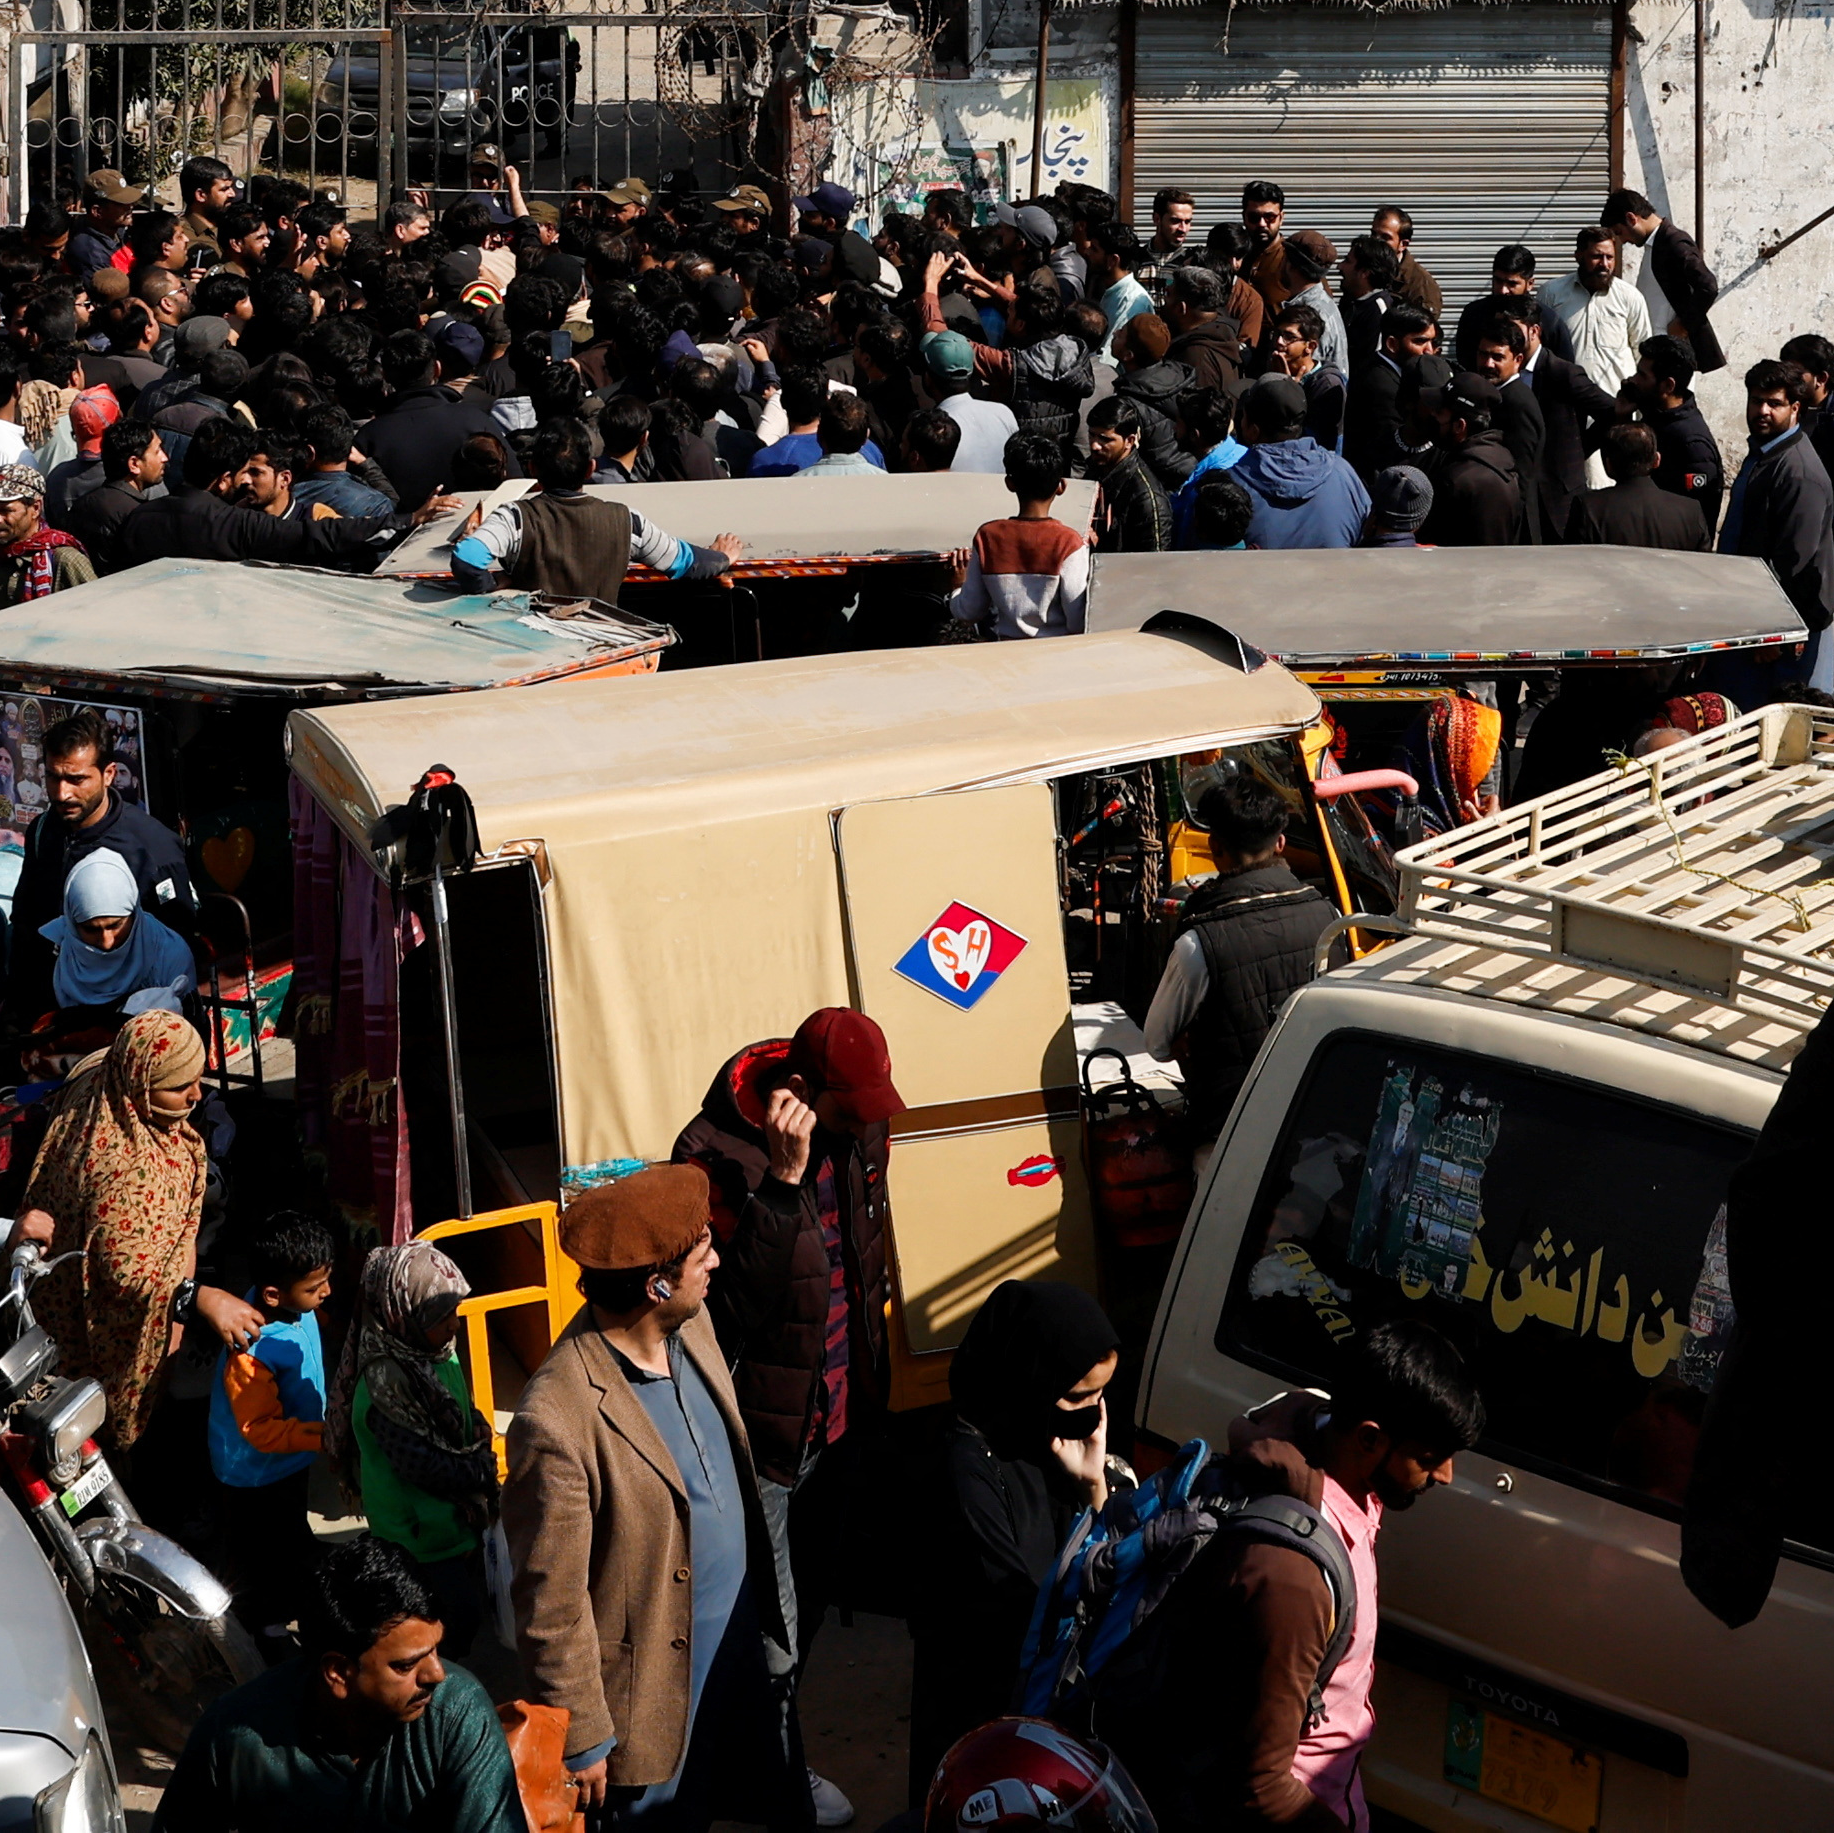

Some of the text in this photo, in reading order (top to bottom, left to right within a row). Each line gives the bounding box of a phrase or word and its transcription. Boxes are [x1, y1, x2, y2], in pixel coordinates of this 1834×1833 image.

[511, 82, 554, 103] POICE
[1491, 1226, 1630, 1343] دانش
[1463, 1673, 1561, 1728] TOYOTA
